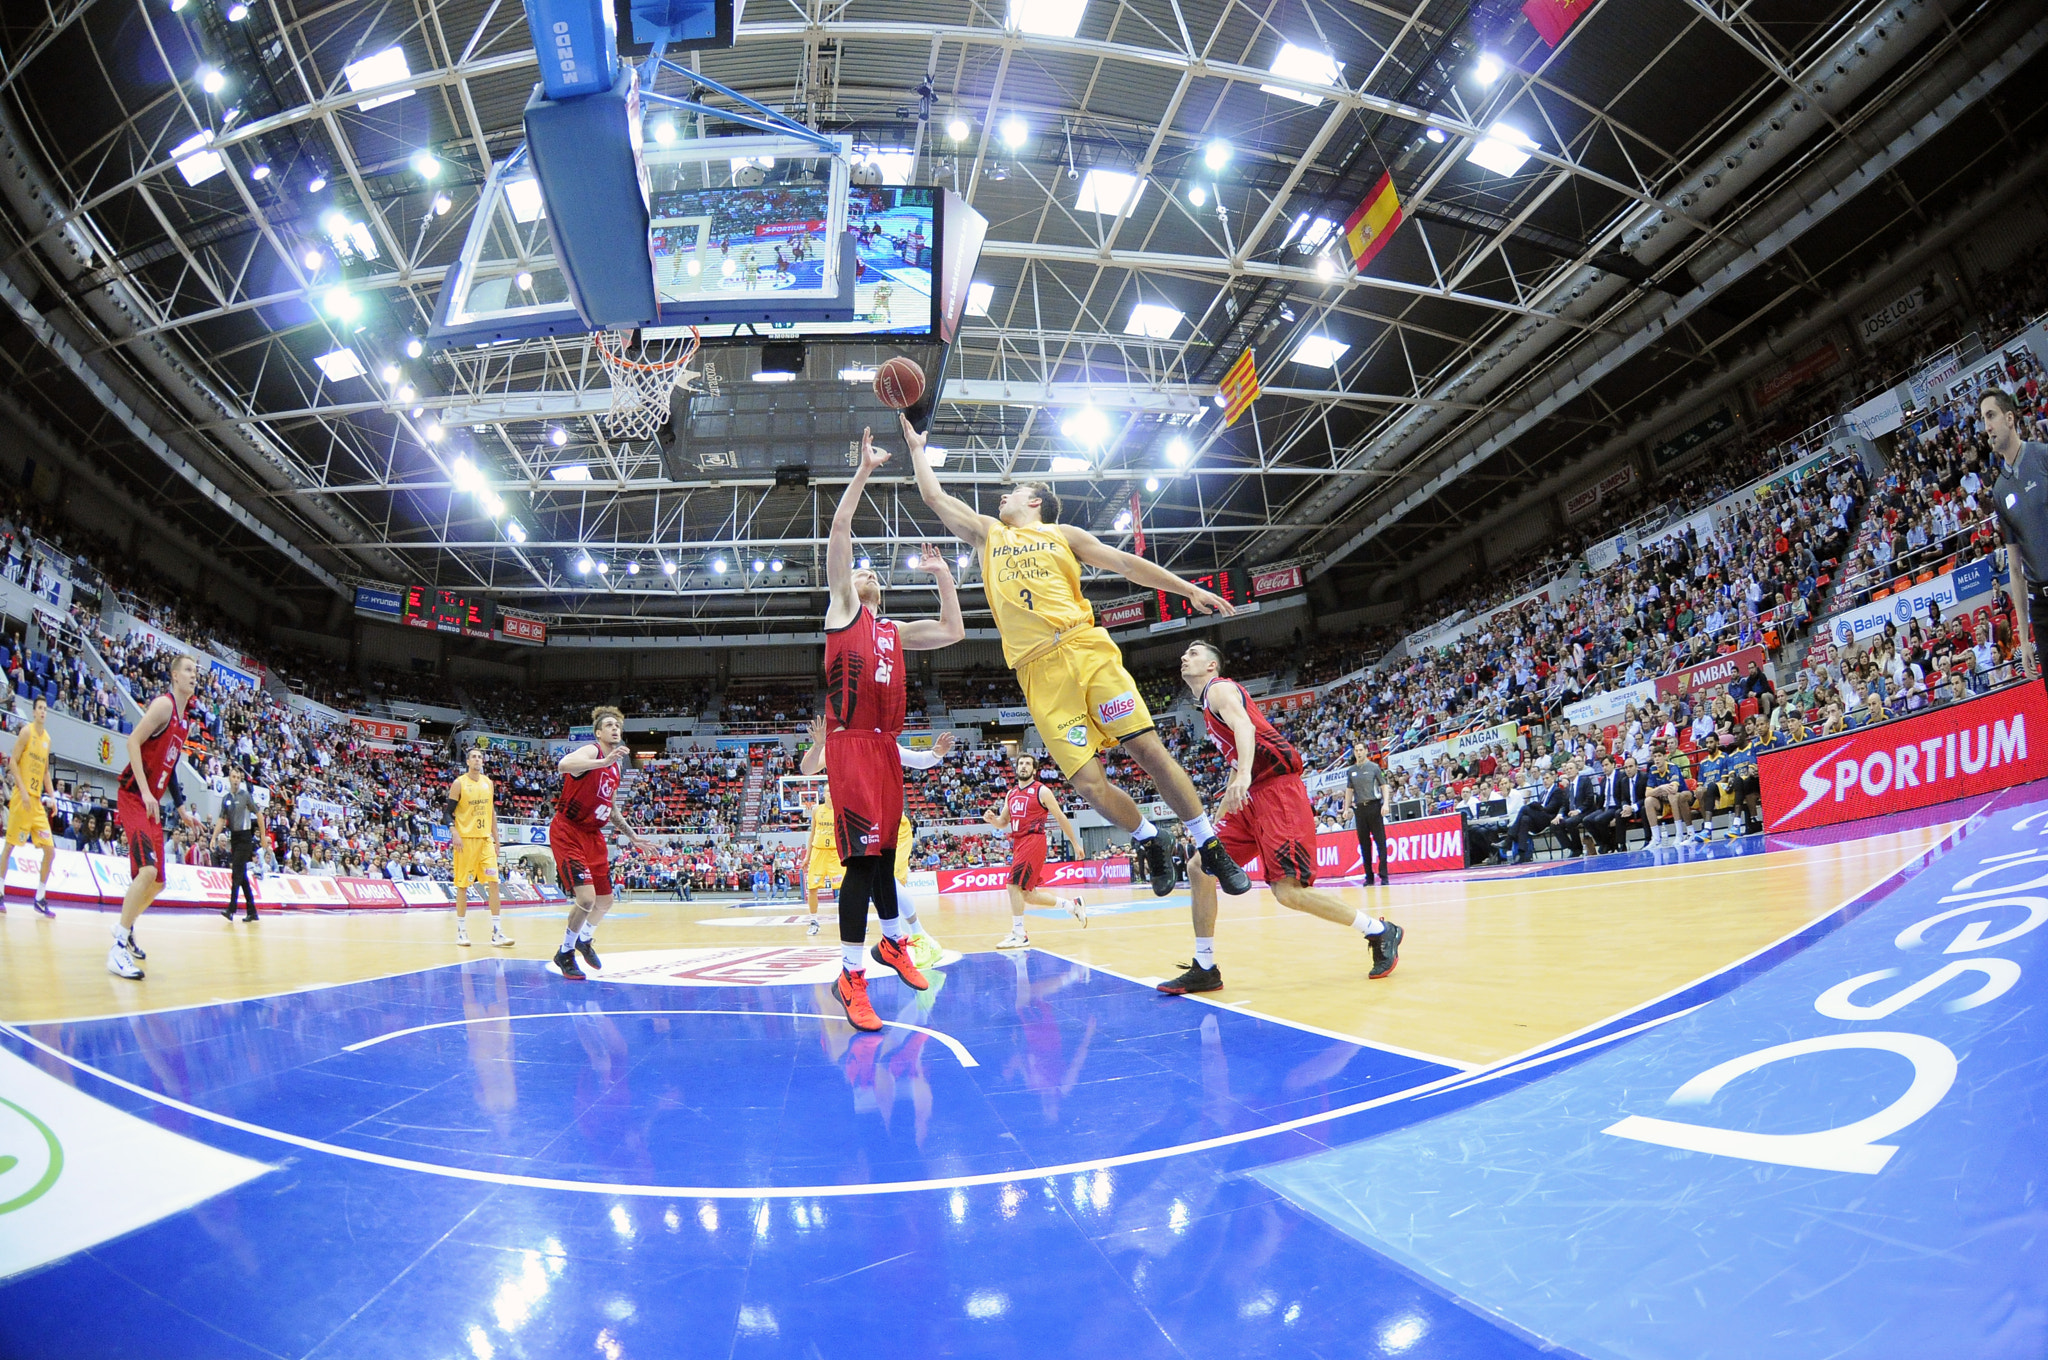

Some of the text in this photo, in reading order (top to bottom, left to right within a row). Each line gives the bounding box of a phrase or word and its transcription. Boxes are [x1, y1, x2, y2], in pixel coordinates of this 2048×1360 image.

[553, 21, 579, 84] MONDO
[370, 597, 400, 608] HYUNDAI
[1020, 589, 1033, 610] 3
[1913, 590, 1953, 612] Balay
[1111, 607, 1142, 622] AMBAR
[1854, 612, 1893, 633] Balay
[437, 624, 460, 633] MONDO
[471, 630, 489, 639] AMBAR
[1099, 697, 1135, 723] Kalise
[1458, 729, 1499, 748] ANAGAN
[1768, 713, 2028, 829] SPORTIUM
[30, 777, 39, 792] 22
[595, 804, 612, 822] 42
[476, 818, 485, 829] 34
[825, 838, 831, 848] 9
[1099, 861, 1131, 882] SPORTIUM
[356, 882, 397, 900] AMBAR
[405, 881, 432, 896] DKV
[940, 870, 1010, 894] SPORT
